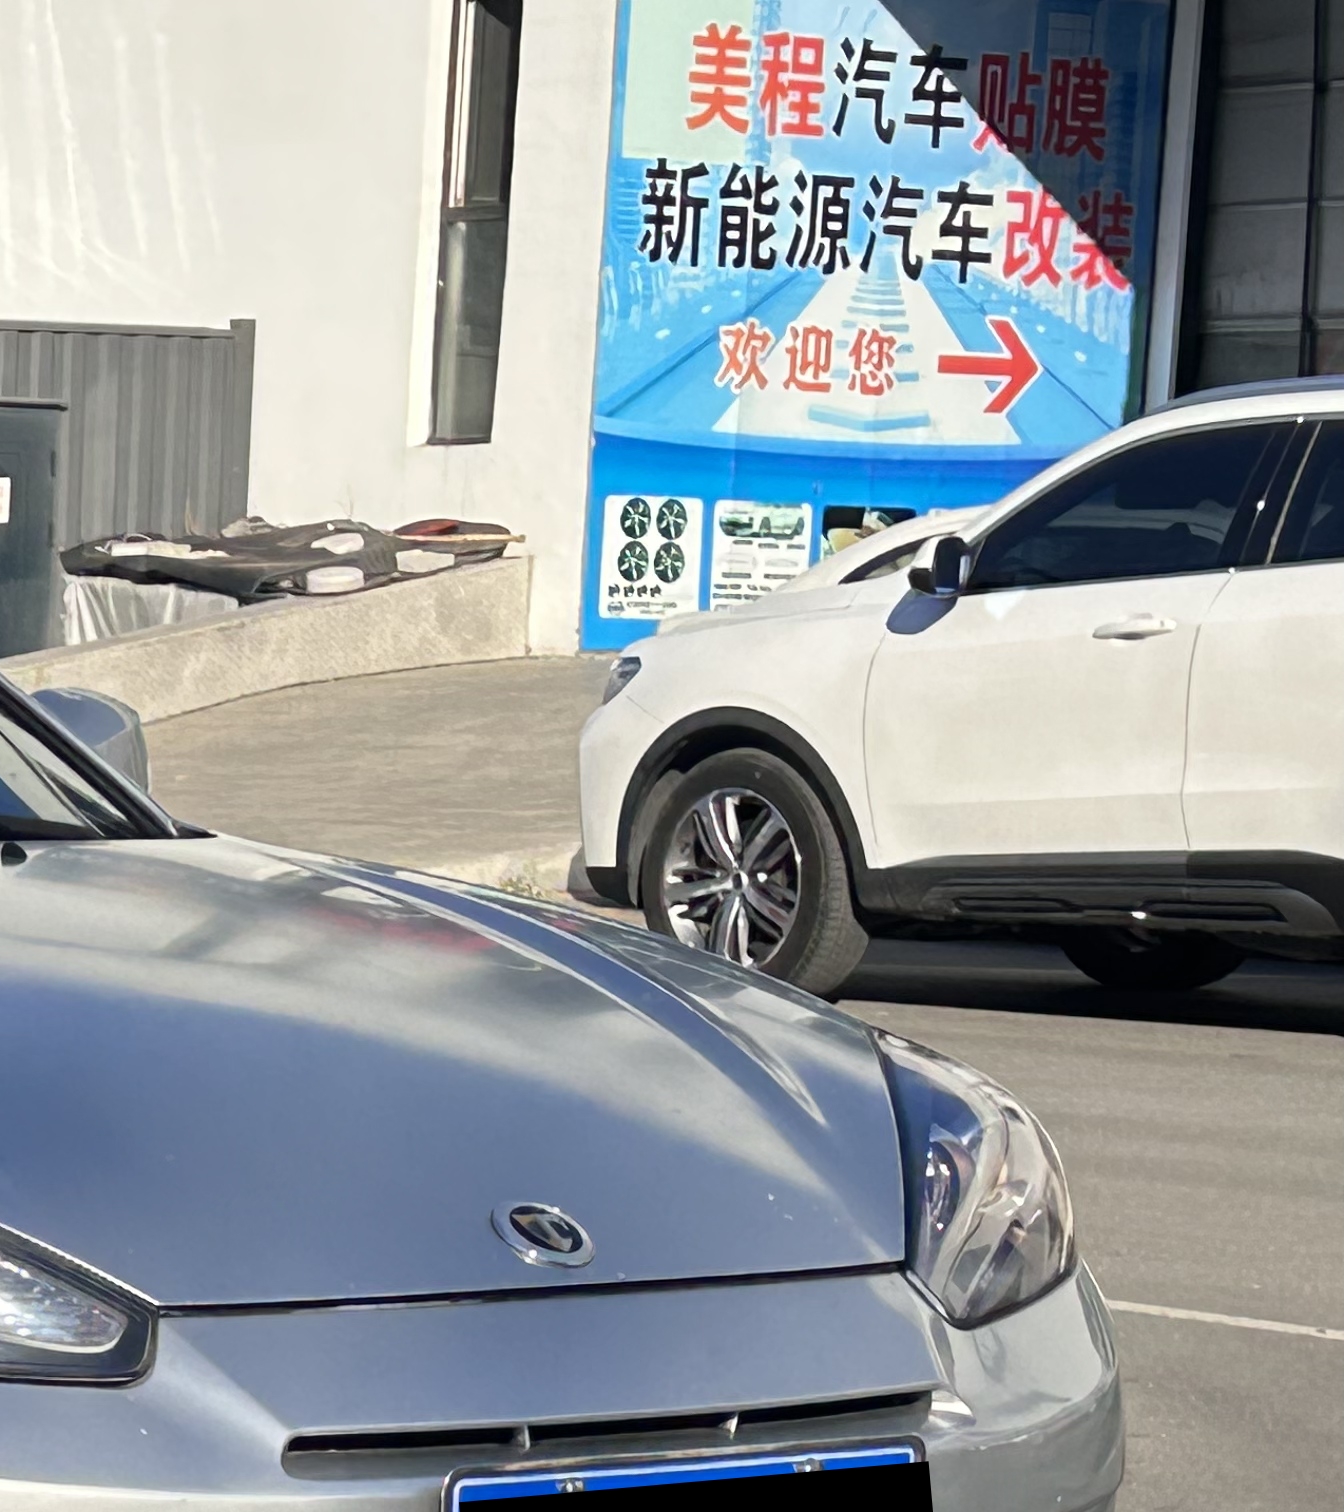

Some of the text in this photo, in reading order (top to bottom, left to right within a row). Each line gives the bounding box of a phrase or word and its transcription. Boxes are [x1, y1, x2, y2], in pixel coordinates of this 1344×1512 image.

[685, 22, 1111, 162] 美程汽车贴膜
[637, 157, 1136, 292] 新能源汽车改装
[715, 320, 898, 396] 欢迎您
